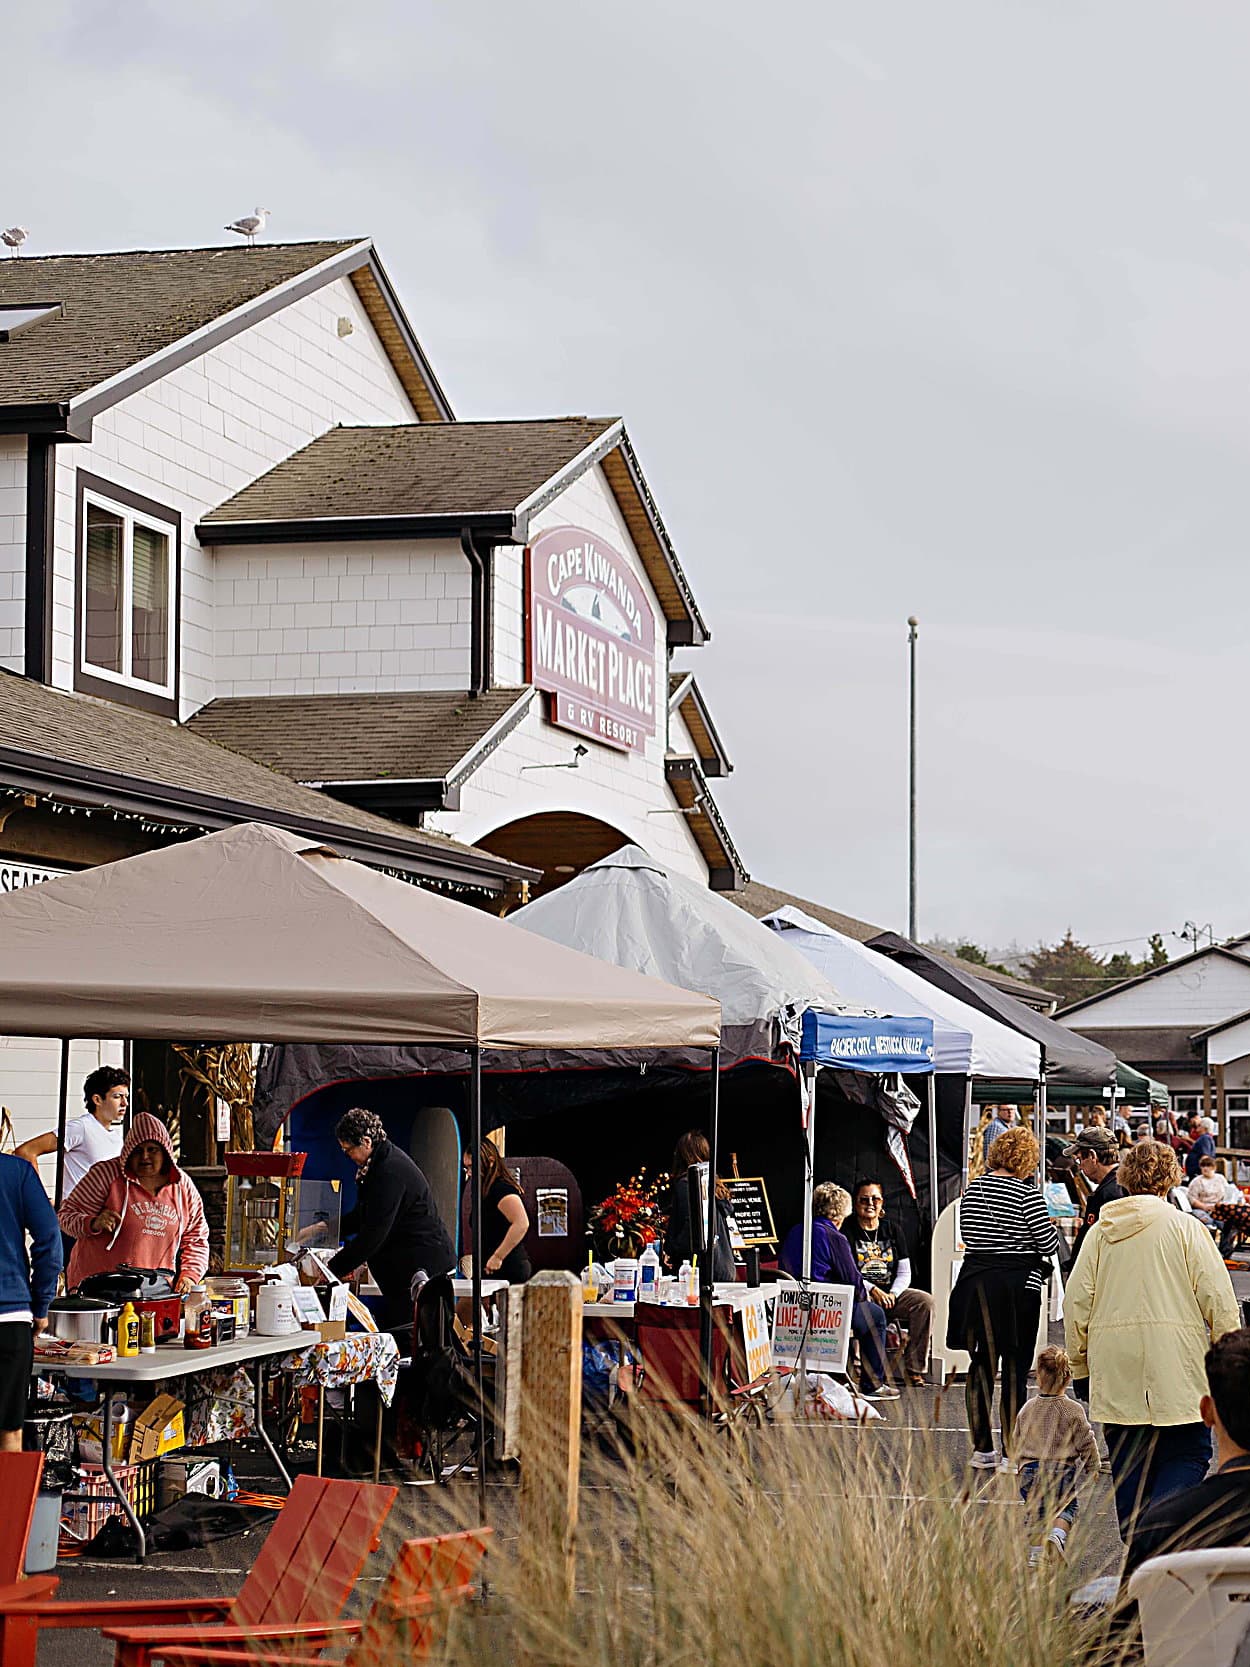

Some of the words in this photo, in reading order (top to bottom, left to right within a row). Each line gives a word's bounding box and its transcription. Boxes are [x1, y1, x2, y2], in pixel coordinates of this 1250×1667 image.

[547, 547, 583, 597] CAPE
[584, 542, 643, 640] KIWANDA
[566, 703, 576, 721] &
[580, 706, 596, 729] RV
[599, 715, 639, 748] RESORT
[1, 868, 59, 892] SEAF
[830, 1038, 858, 1057] PACIFIC
[856, 1036, 871, 1056] CITY
[142, 1228, 167, 1239] OREGON
[776, 1306, 798, 1327] LINE
